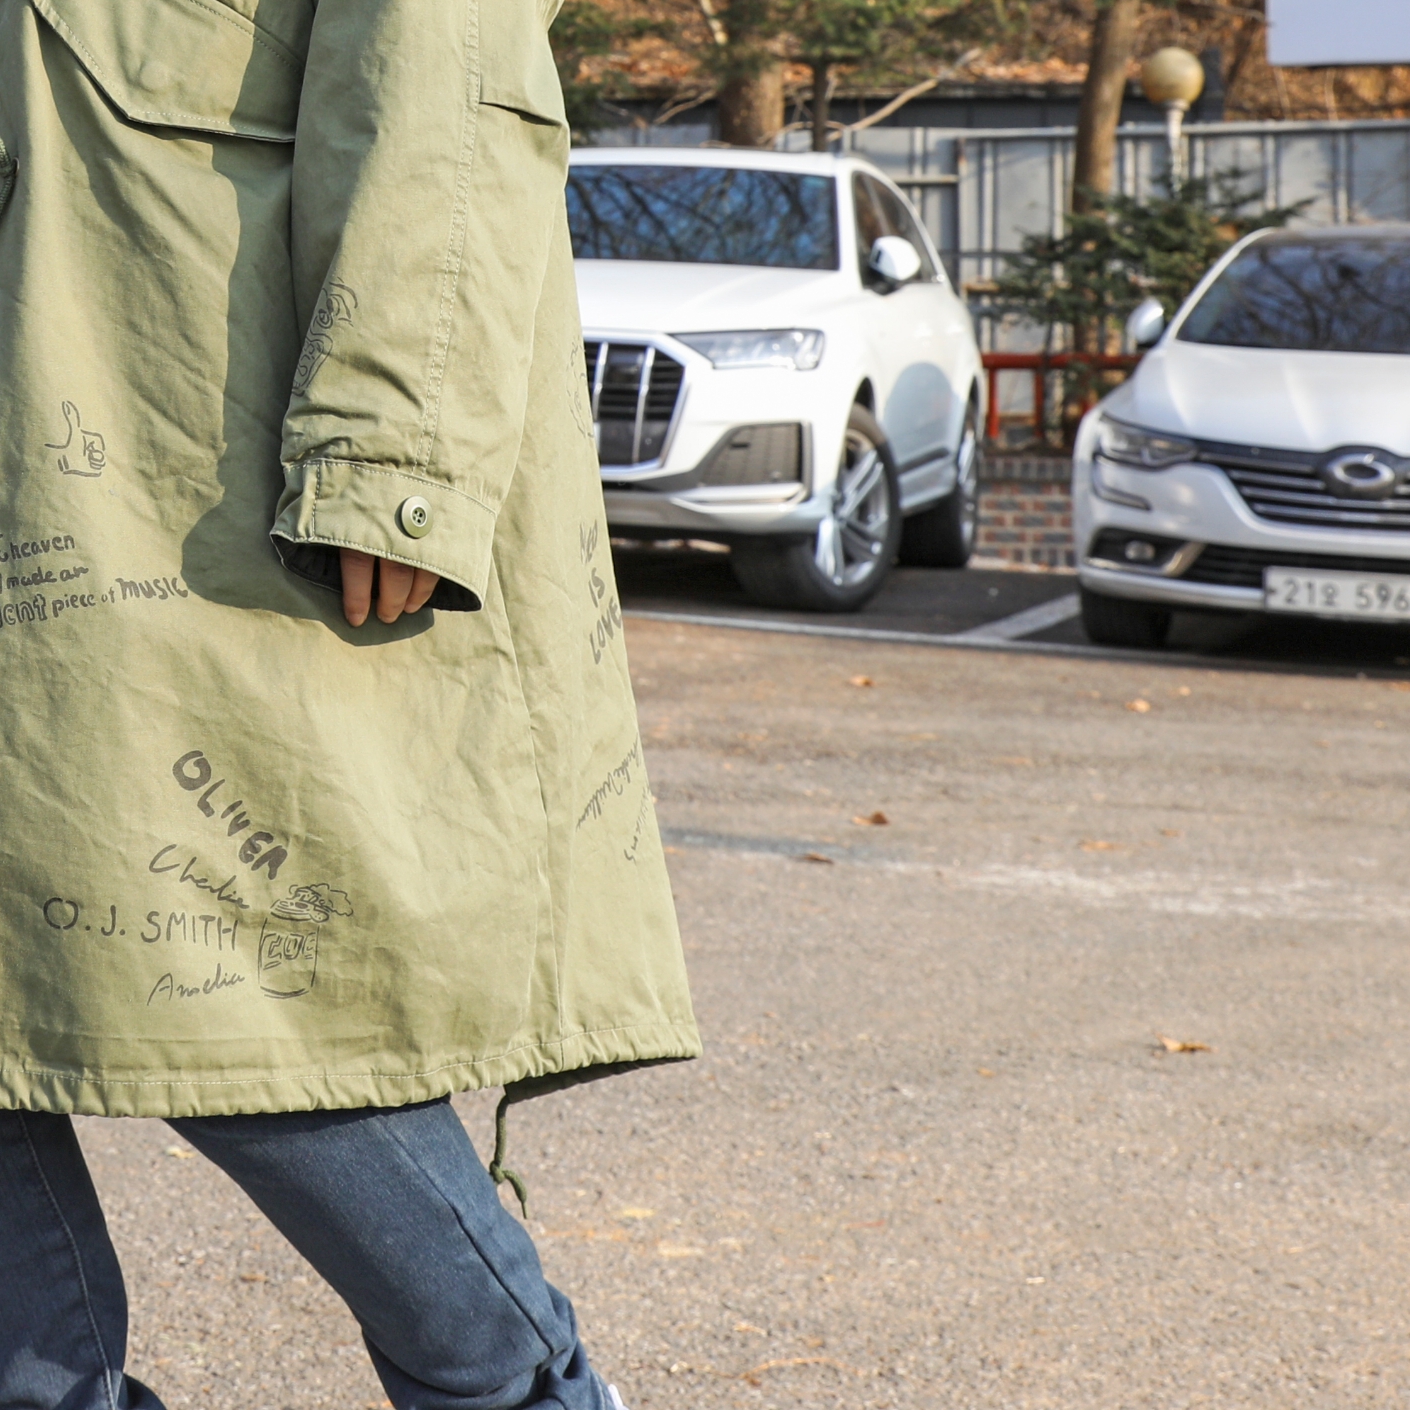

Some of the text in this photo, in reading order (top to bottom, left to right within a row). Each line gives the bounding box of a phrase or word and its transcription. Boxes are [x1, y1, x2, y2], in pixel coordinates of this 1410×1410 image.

[10, 535, 76, 560] heaven
[6, 566, 57, 590] made
[52, 593, 96, 618] piece
[101, 587, 115, 604] of
[590, 595, 622, 665] LOVE
[172, 750, 288, 880] OLIVER
[141, 910, 238, 950] SMITH
